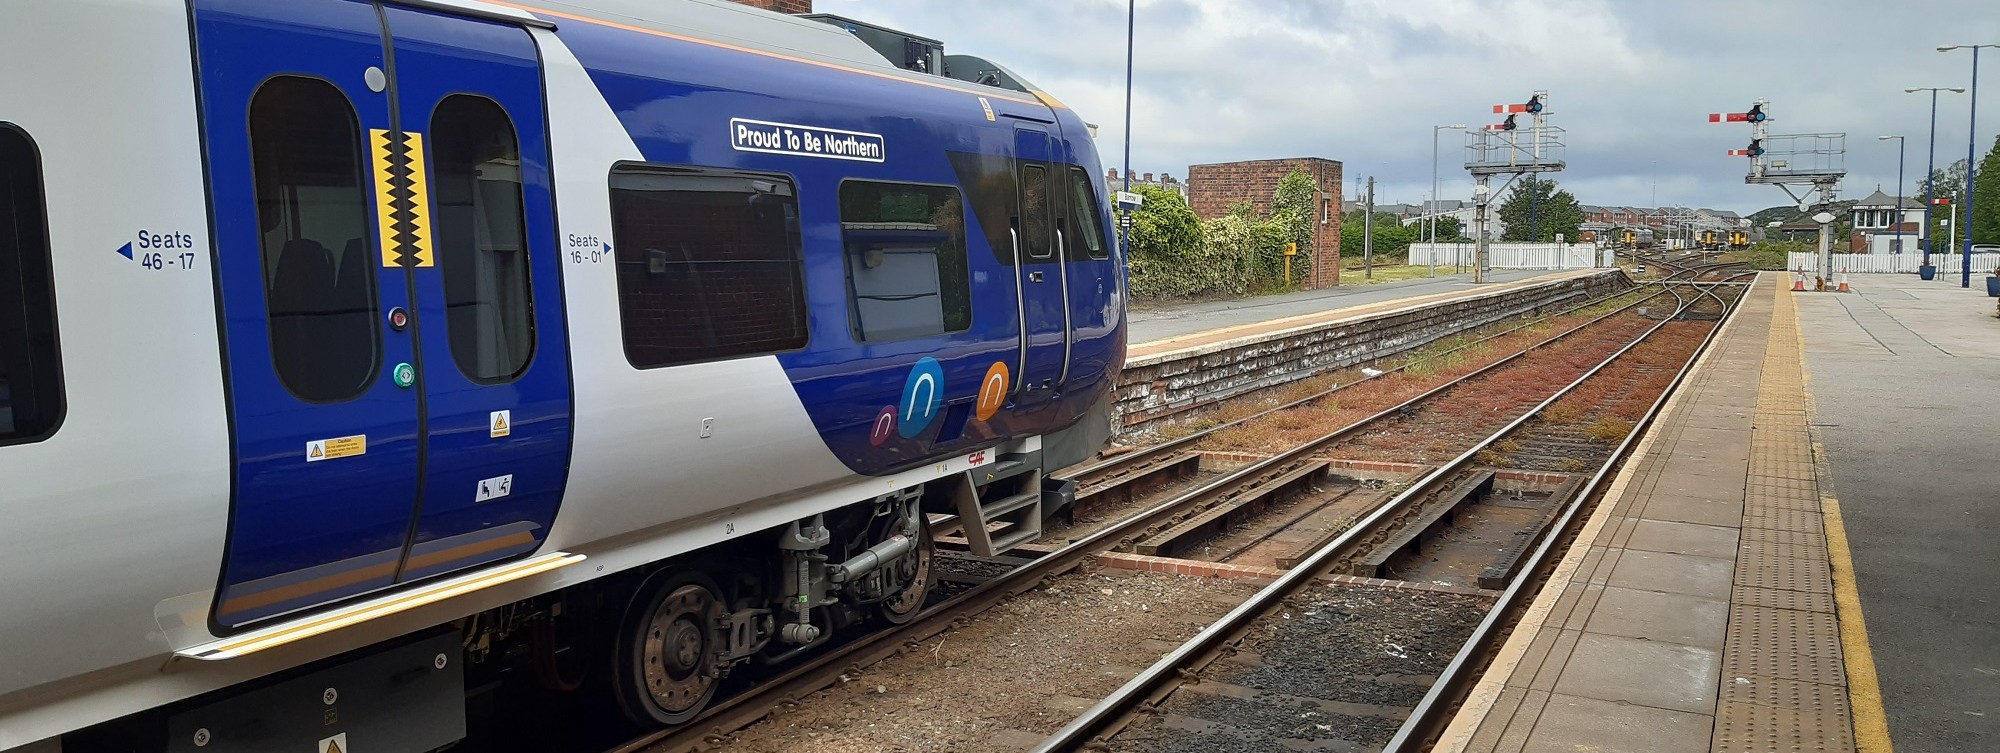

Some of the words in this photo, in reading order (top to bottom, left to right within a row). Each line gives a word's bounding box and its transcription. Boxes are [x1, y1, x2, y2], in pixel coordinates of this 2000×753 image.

[737, 124, 781, 149] Proud
[784, 129, 800, 150] To
[804, 132, 822, 153] Be
[824, 134, 880, 158] Northern
[138, 229, 193, 249] Seats
[568, 233, 599, 248] Seats
[141, 252, 163, 270] 46
[178, 252, 195, 270] 17
[570, 250, 582, 264] 16
[591, 250, 602, 264] 01
[968, 450, 986, 466] CAF
[726, 522, 735, 535] 2A
